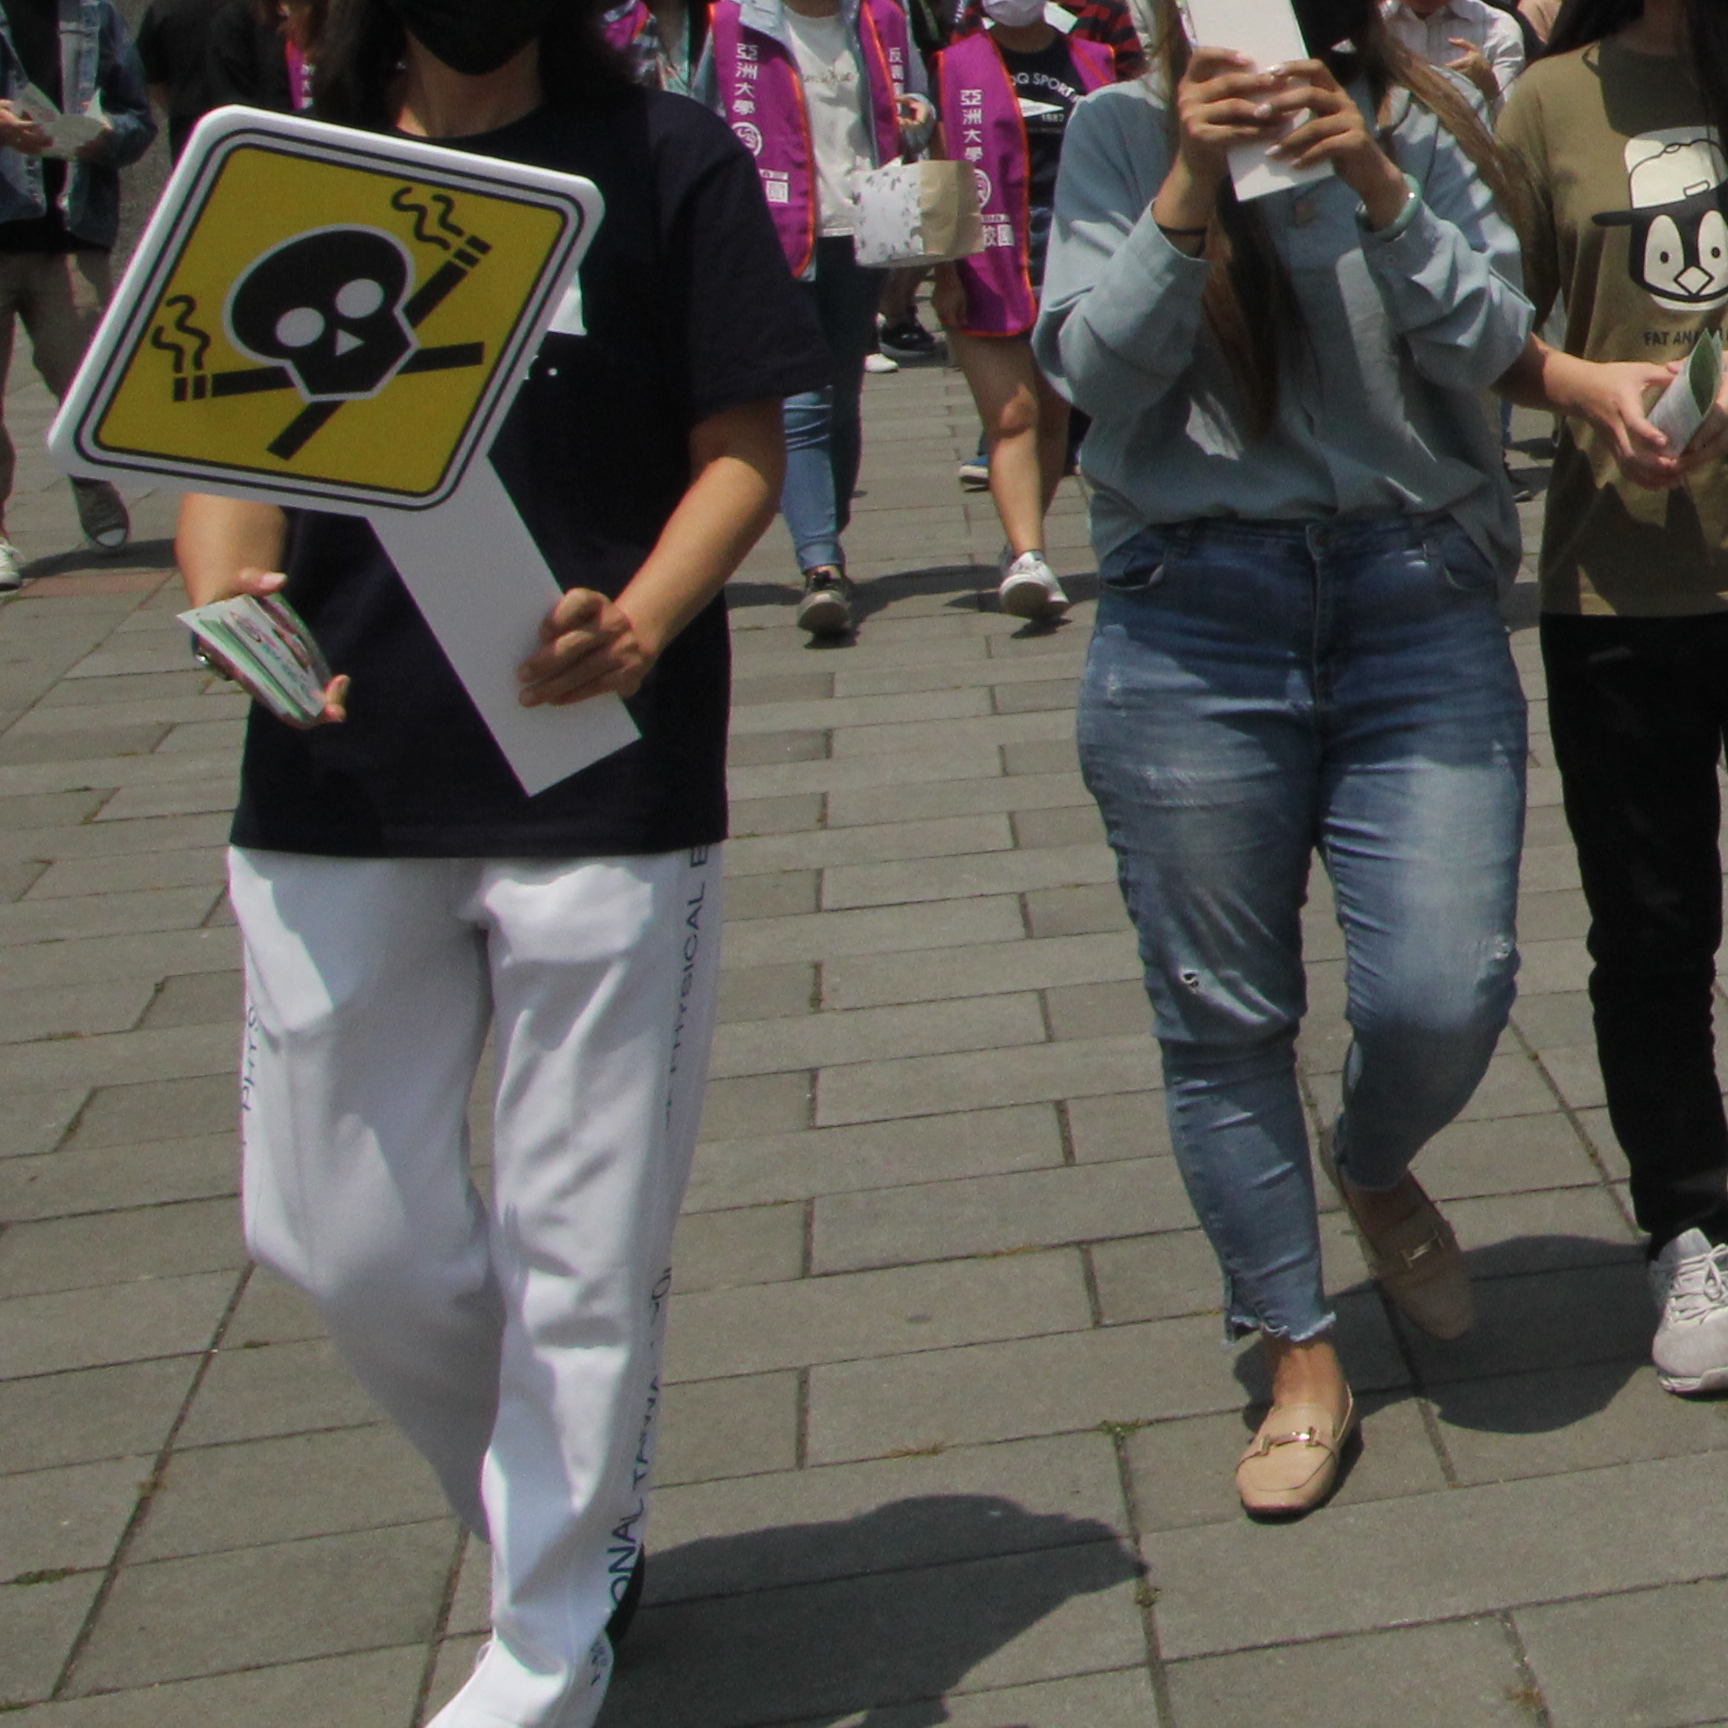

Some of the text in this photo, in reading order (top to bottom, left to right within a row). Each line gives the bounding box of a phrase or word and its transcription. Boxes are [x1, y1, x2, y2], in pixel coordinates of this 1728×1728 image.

[732, 42, 759, 117] 亞洲大學
[960, 88, 985, 163] 亞洲大學
